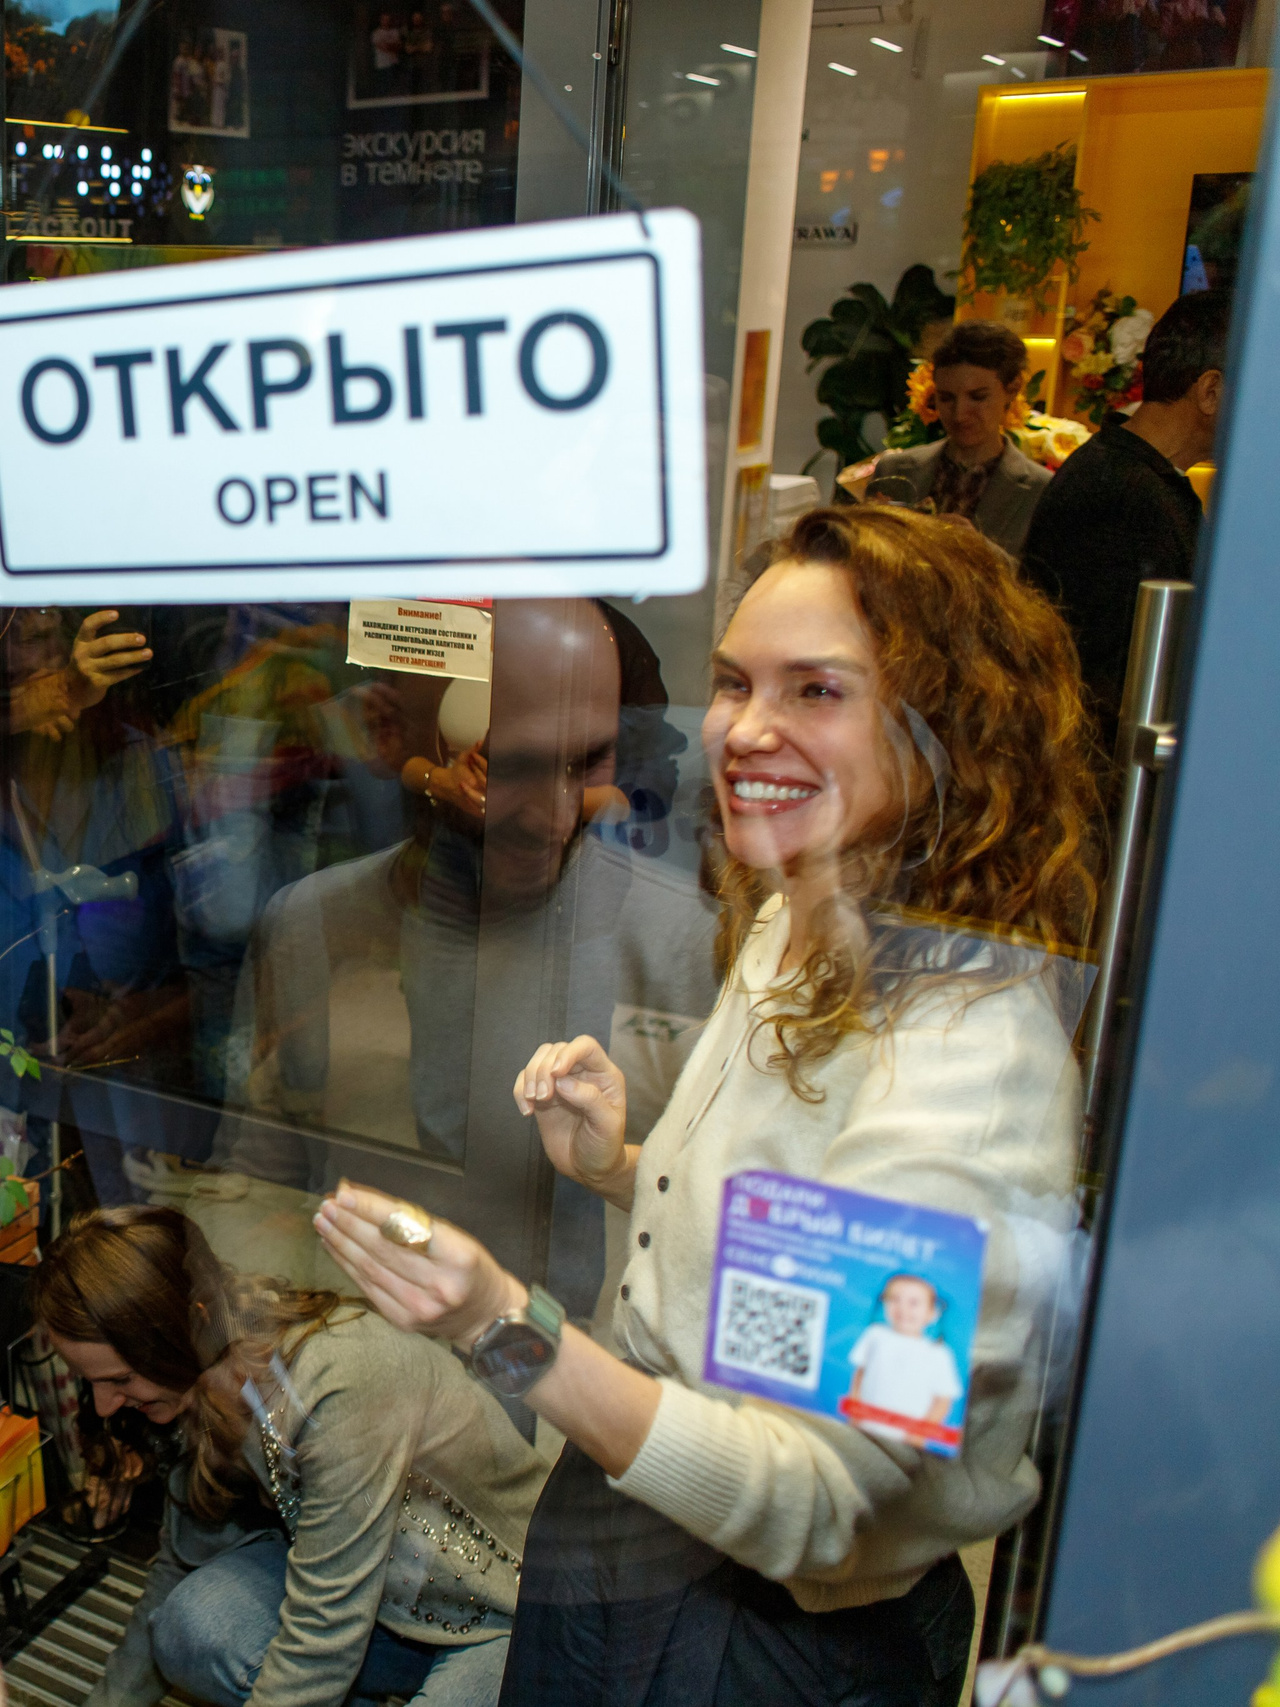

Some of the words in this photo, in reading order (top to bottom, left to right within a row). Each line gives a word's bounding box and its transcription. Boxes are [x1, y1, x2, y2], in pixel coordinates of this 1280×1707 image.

[21, 311, 609, 446] ОТКРЫТО
[217, 470, 390, 526] OPEN
[397, 607, 442, 621] Внимание!
[362, 620, 399, 632] НАХОЖДЕНИЕ
[400, 624, 405, 633] В
[405, 625, 438, 636] НЕТРЕЗВОМ
[438, 629, 472, 640] СОСТОЯНИИ
[364, 631, 392, 641] РАСПИТИЕ
[393, 634, 435, 646] АЛКОГОЛЬНЫХ
[435, 639, 466, 650] НАПИТКОВ
[466, 643, 475, 651] НА
[391, 645, 426, 656] ТЕРРИТОРИИ
[426, 649, 445, 658] МУЗЕЯ
[389, 655, 410, 664] СТРОГО
[410, 657, 446, 669] ЗАПРЕЩЕНО!
[729, 1193, 844, 1236] ДБРЫЙ
